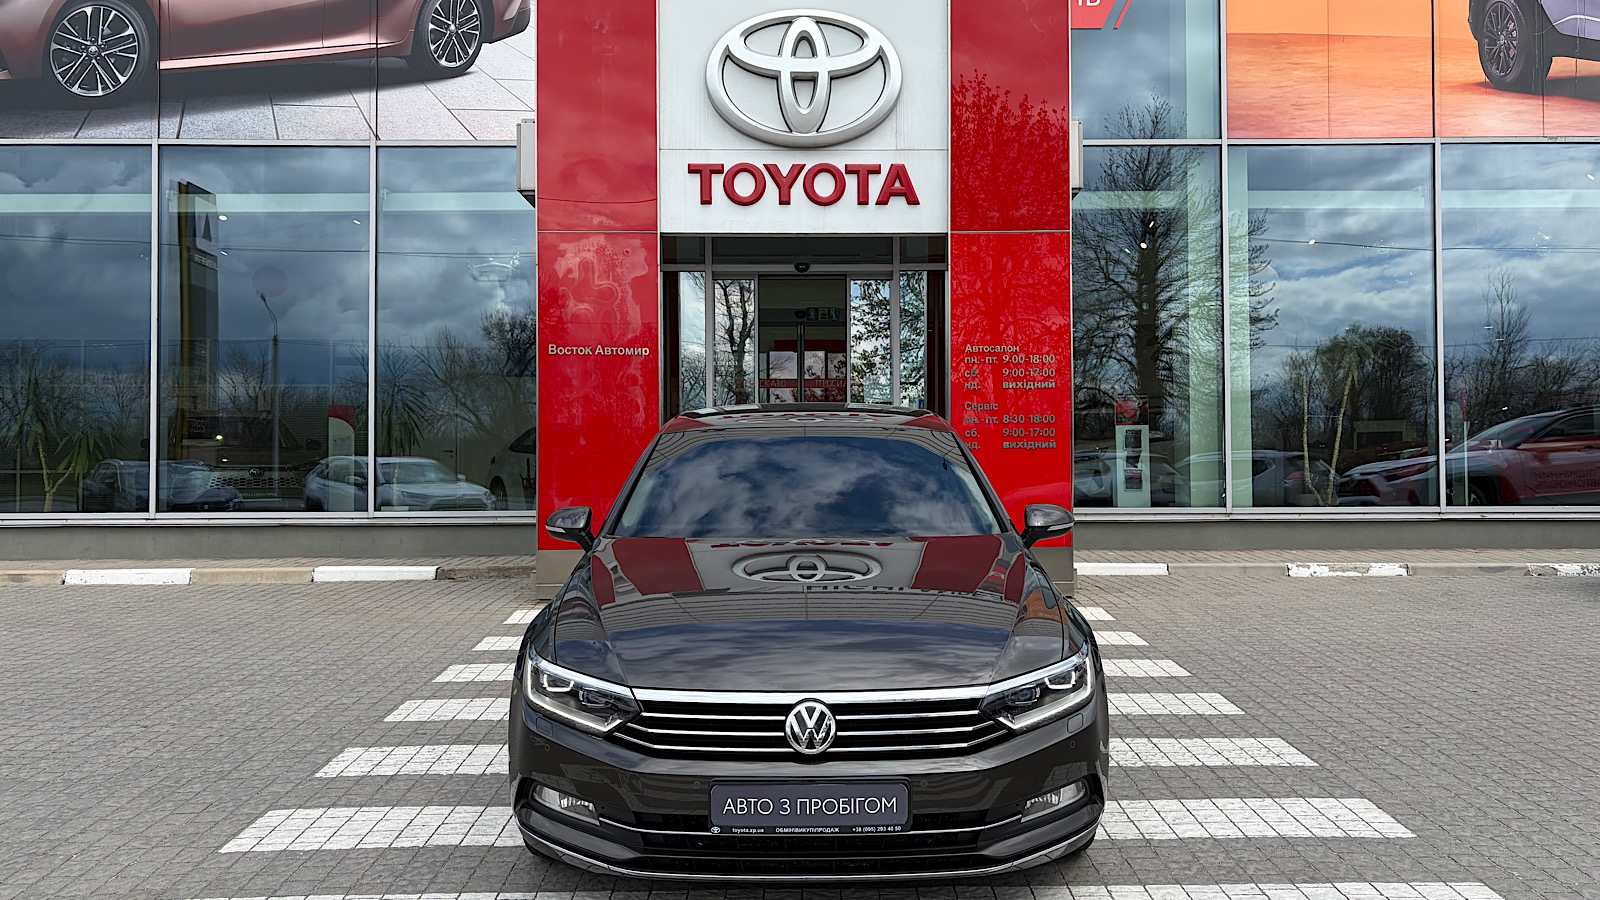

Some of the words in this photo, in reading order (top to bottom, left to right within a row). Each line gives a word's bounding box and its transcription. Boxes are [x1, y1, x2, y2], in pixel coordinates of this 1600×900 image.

[688, 162, 920, 206] TOYOTA
[548, 344, 592, 355] Восток
[595, 345, 650, 358] Автомир
[965, 344, 1020, 353] Автосалон
[1002, 354, 1056, 364] 9:00-18:00
[964, 369, 980, 378] сб.
[1002, 368, 1056, 377] 9:00-17:00
[964, 381, 981, 390] нд.
[1002, 380, 1056, 390] вихідний
[964, 401, 999, 412] Сервіс
[964, 428, 980, 438] сб.
[1002, 428, 1056, 437] 9:00-17:00
[965, 441, 981, 450] нд.
[1003, 439, 1057, 450] вихідний
[722, 798, 774, 815] АВТО
[797, 797, 897, 815] ПРОБІГОМ
